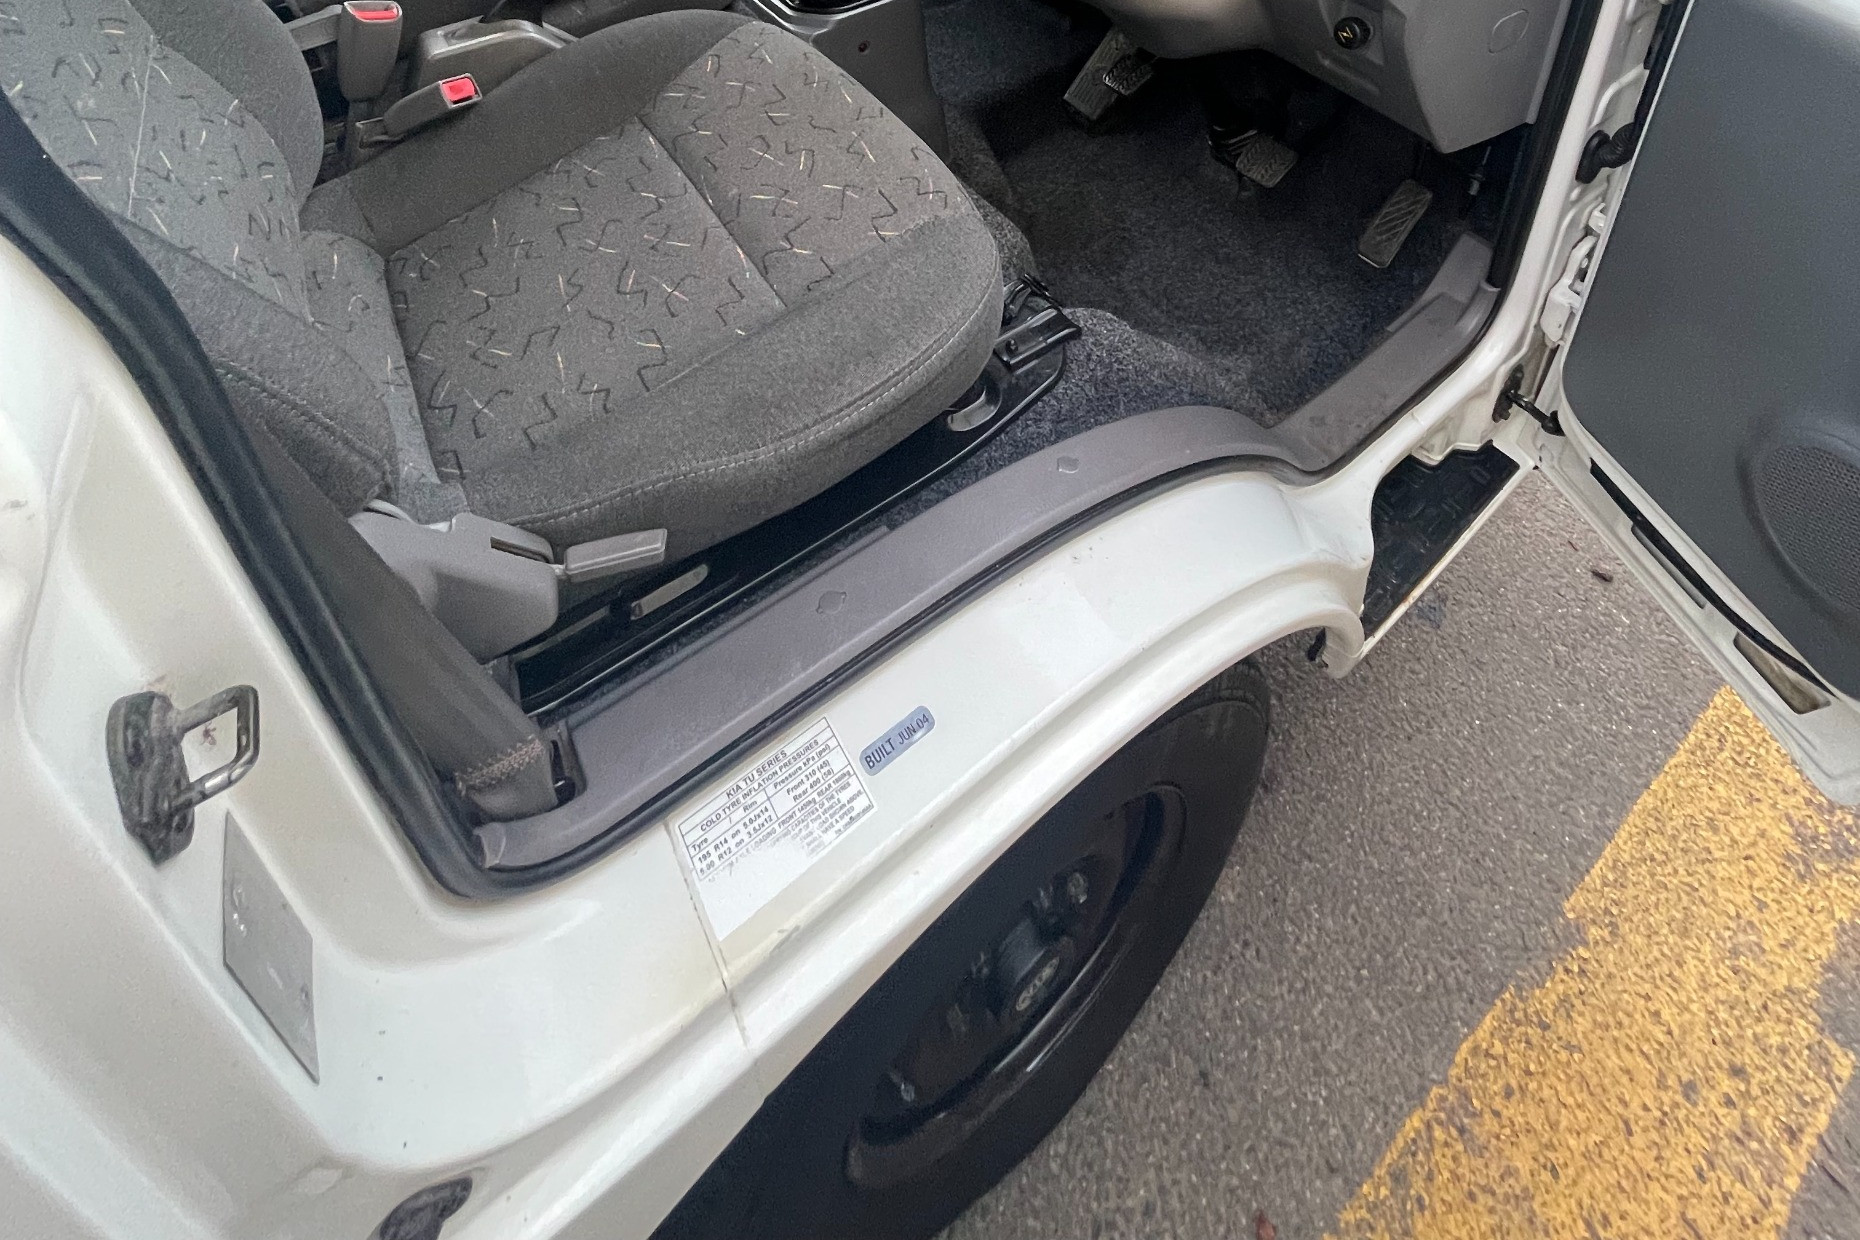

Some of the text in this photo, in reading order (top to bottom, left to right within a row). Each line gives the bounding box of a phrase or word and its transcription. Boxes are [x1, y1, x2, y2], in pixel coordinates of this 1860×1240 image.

[864, 713, 930, 770] BUILT JUN 04
[700, 738, 819, 832] COLD TYRE INFLATION PRESSURES
[725, 749, 787, 799] KIA TU SERIES
[773, 742, 831, 789] Pressure kPa (psi)
[785, 758, 830, 795] Front 310 (45)
[777, 810, 797, 829] FRONT
[816, 782, 832, 798] REAR
[790, 780, 851, 831] CAPACITIES OF THE TYRES
[792, 786, 809, 803] Rear
[808, 776, 821, 790] 400
[820, 797, 841, 817] VEHICLE
[838, 804, 855, 821] SPEED
[691, 835, 709, 854] Tyre
[742, 797, 757, 813] Rim
[697, 849, 711, 864] 195
[713, 836, 728, 852] R14
[730, 828, 740, 839] on
[717, 846, 732, 862] R12
[734, 837, 745, 848] on
